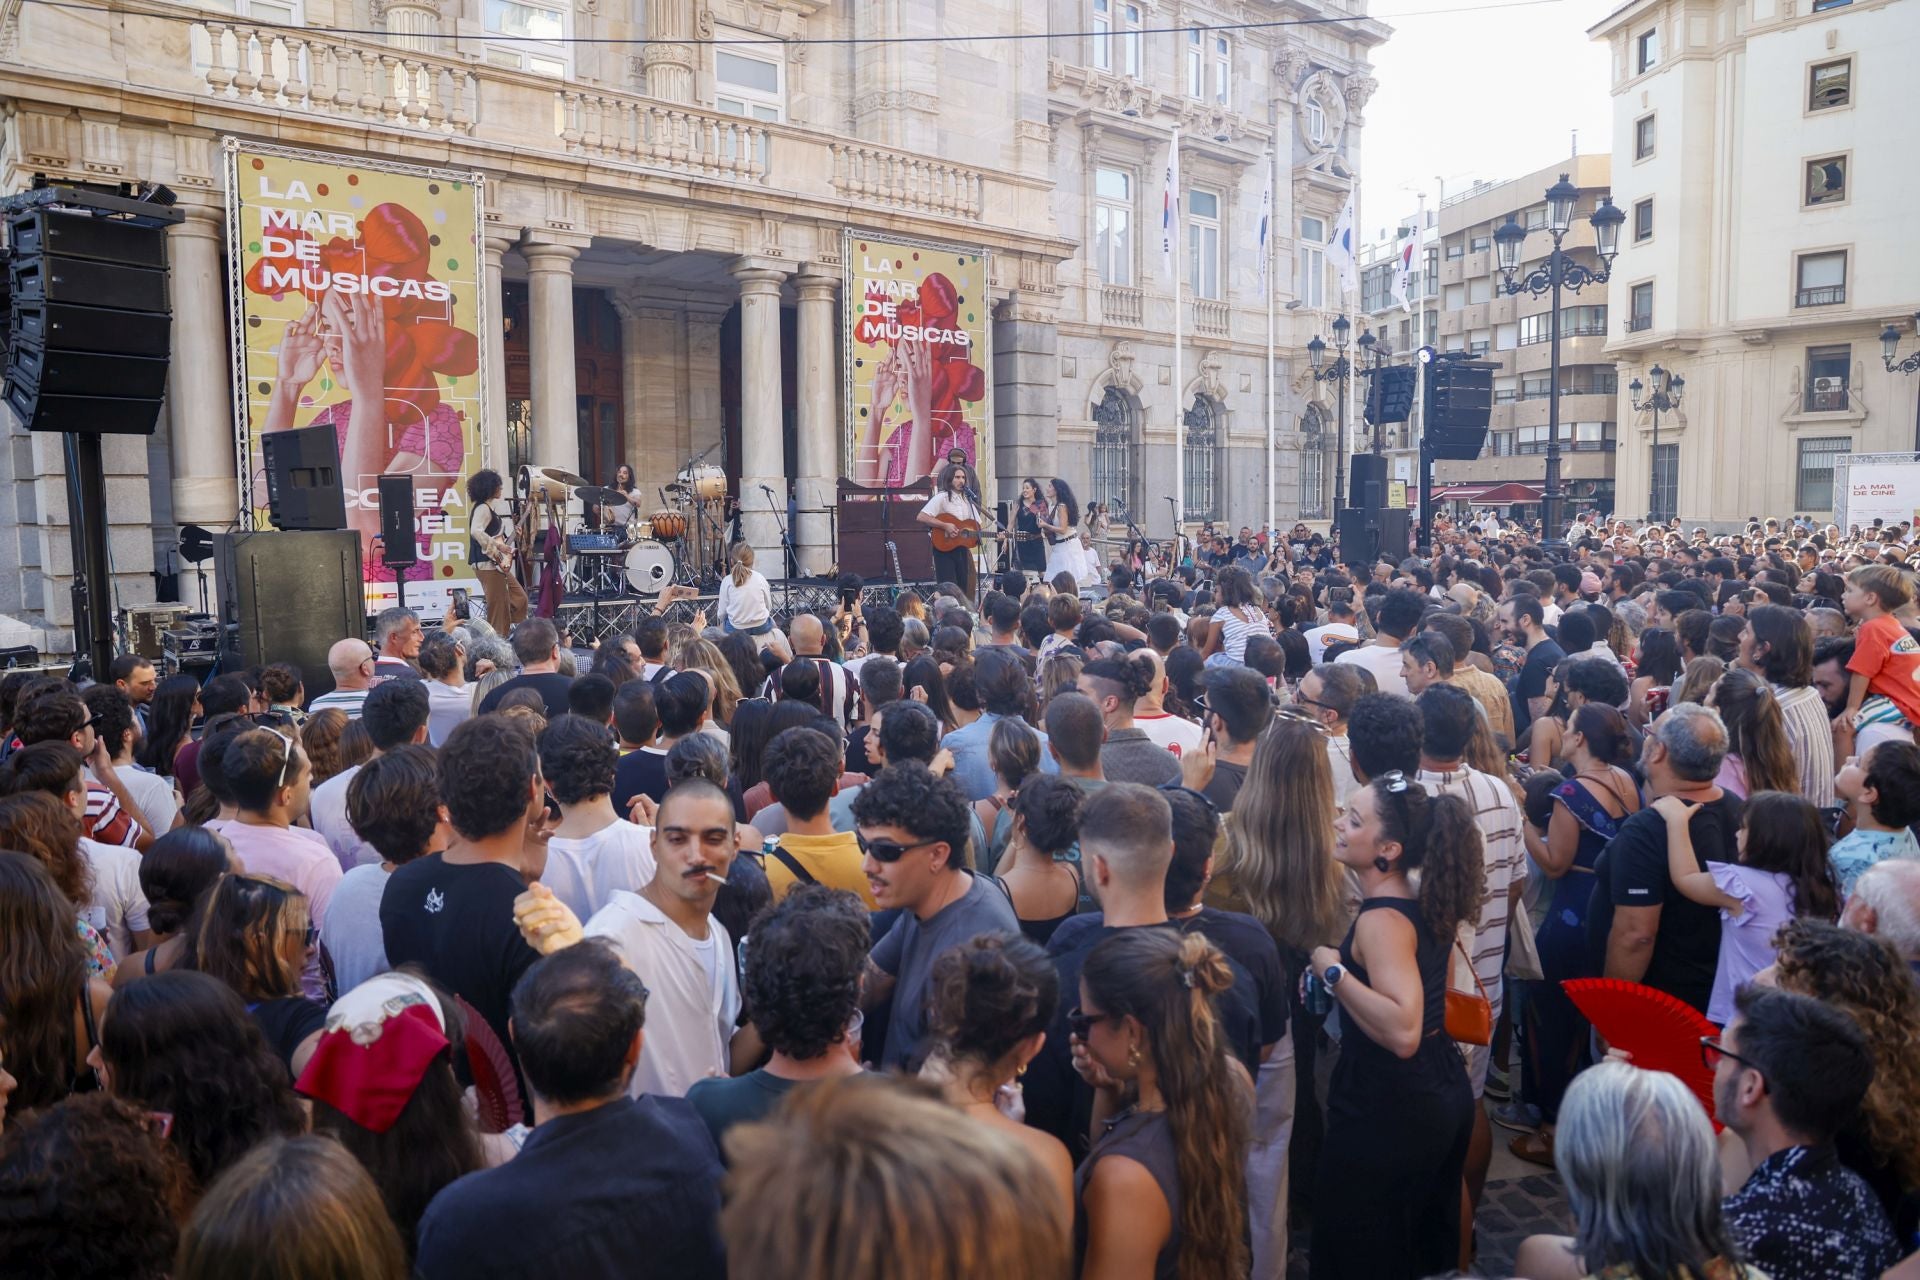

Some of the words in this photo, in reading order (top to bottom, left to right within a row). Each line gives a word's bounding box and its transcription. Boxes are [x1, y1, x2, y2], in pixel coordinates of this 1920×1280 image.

[259, 176, 312, 203] LA
[260, 207, 355, 236] MAR
[262, 236, 321, 262] DE
[863, 256, 893, 274] LA
[262, 263, 451, 301] MÚSICAS
[863, 279, 917, 299] MAR
[863, 300, 897, 318] DE
[863, 319, 970, 345] MÚSICAS
[343, 488, 463, 508] COEA
[414, 515, 465, 534] EL
